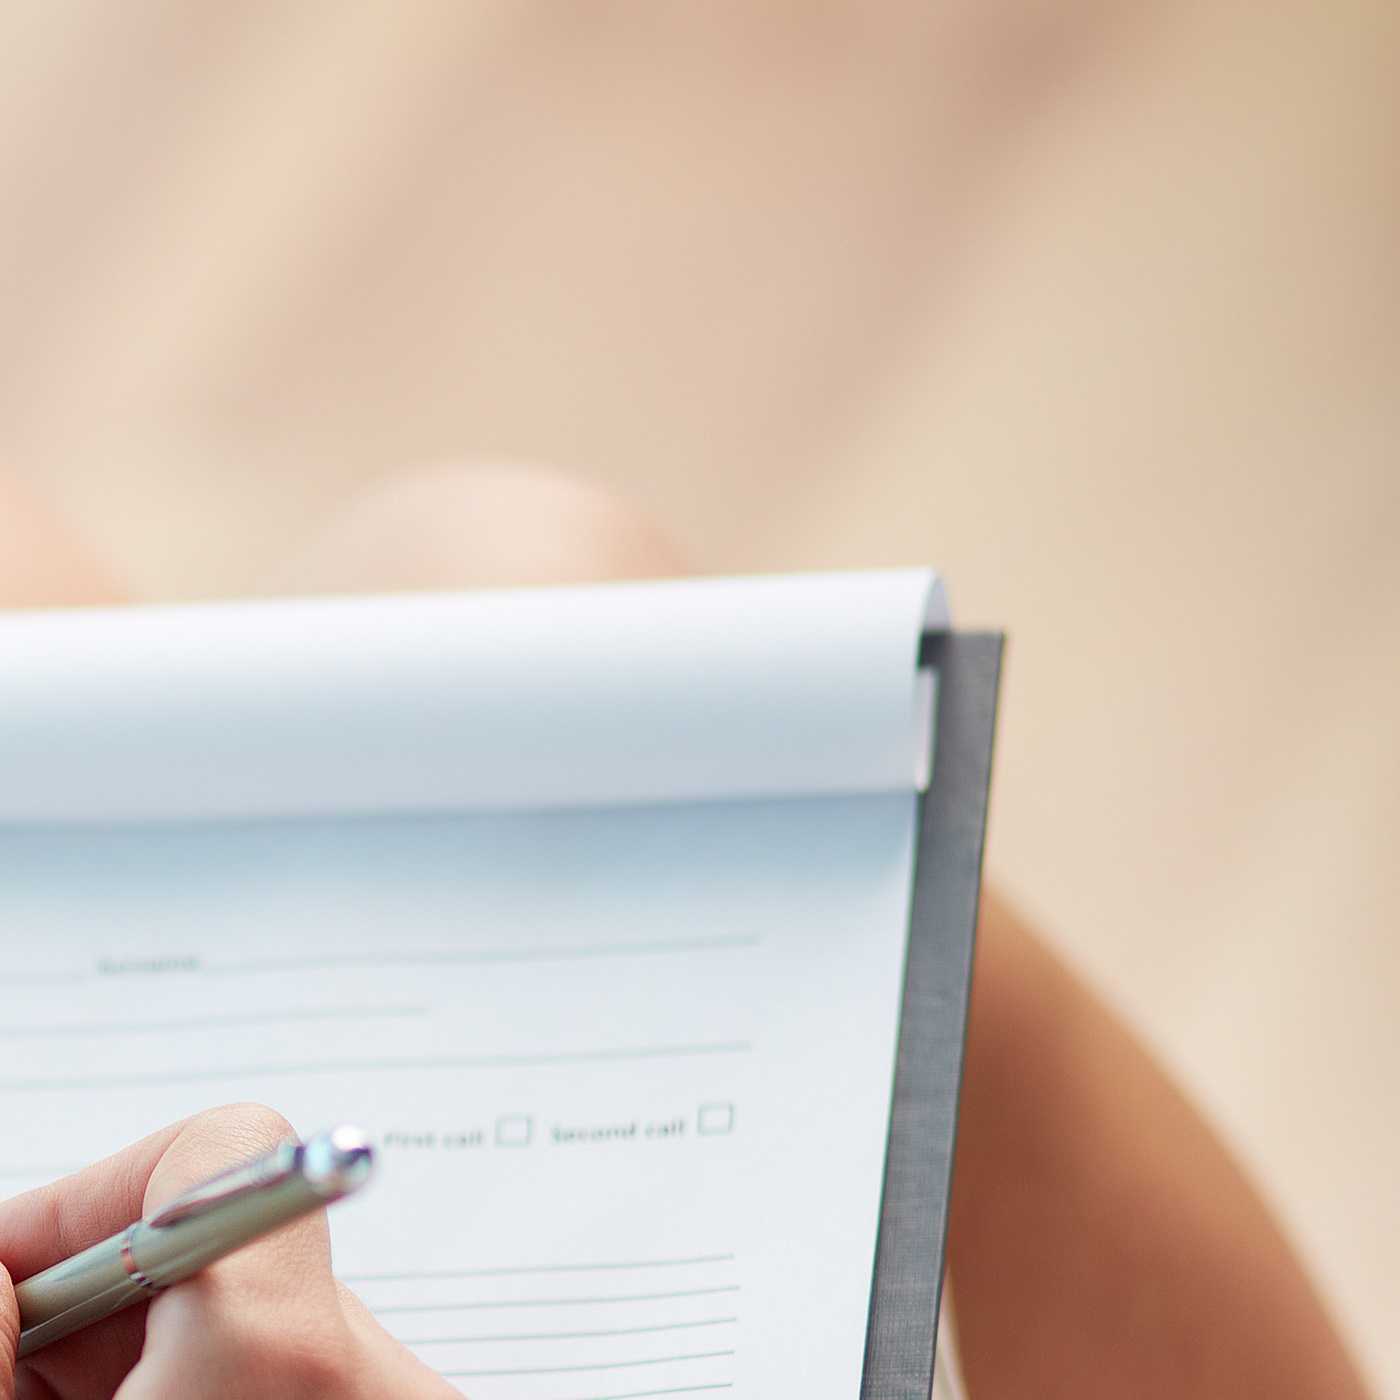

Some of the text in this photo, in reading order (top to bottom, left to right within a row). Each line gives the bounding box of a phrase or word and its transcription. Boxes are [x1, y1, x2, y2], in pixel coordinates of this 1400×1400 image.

[383, 1129, 484, 1148] First call
[551, 1118, 685, 1145] Second call
